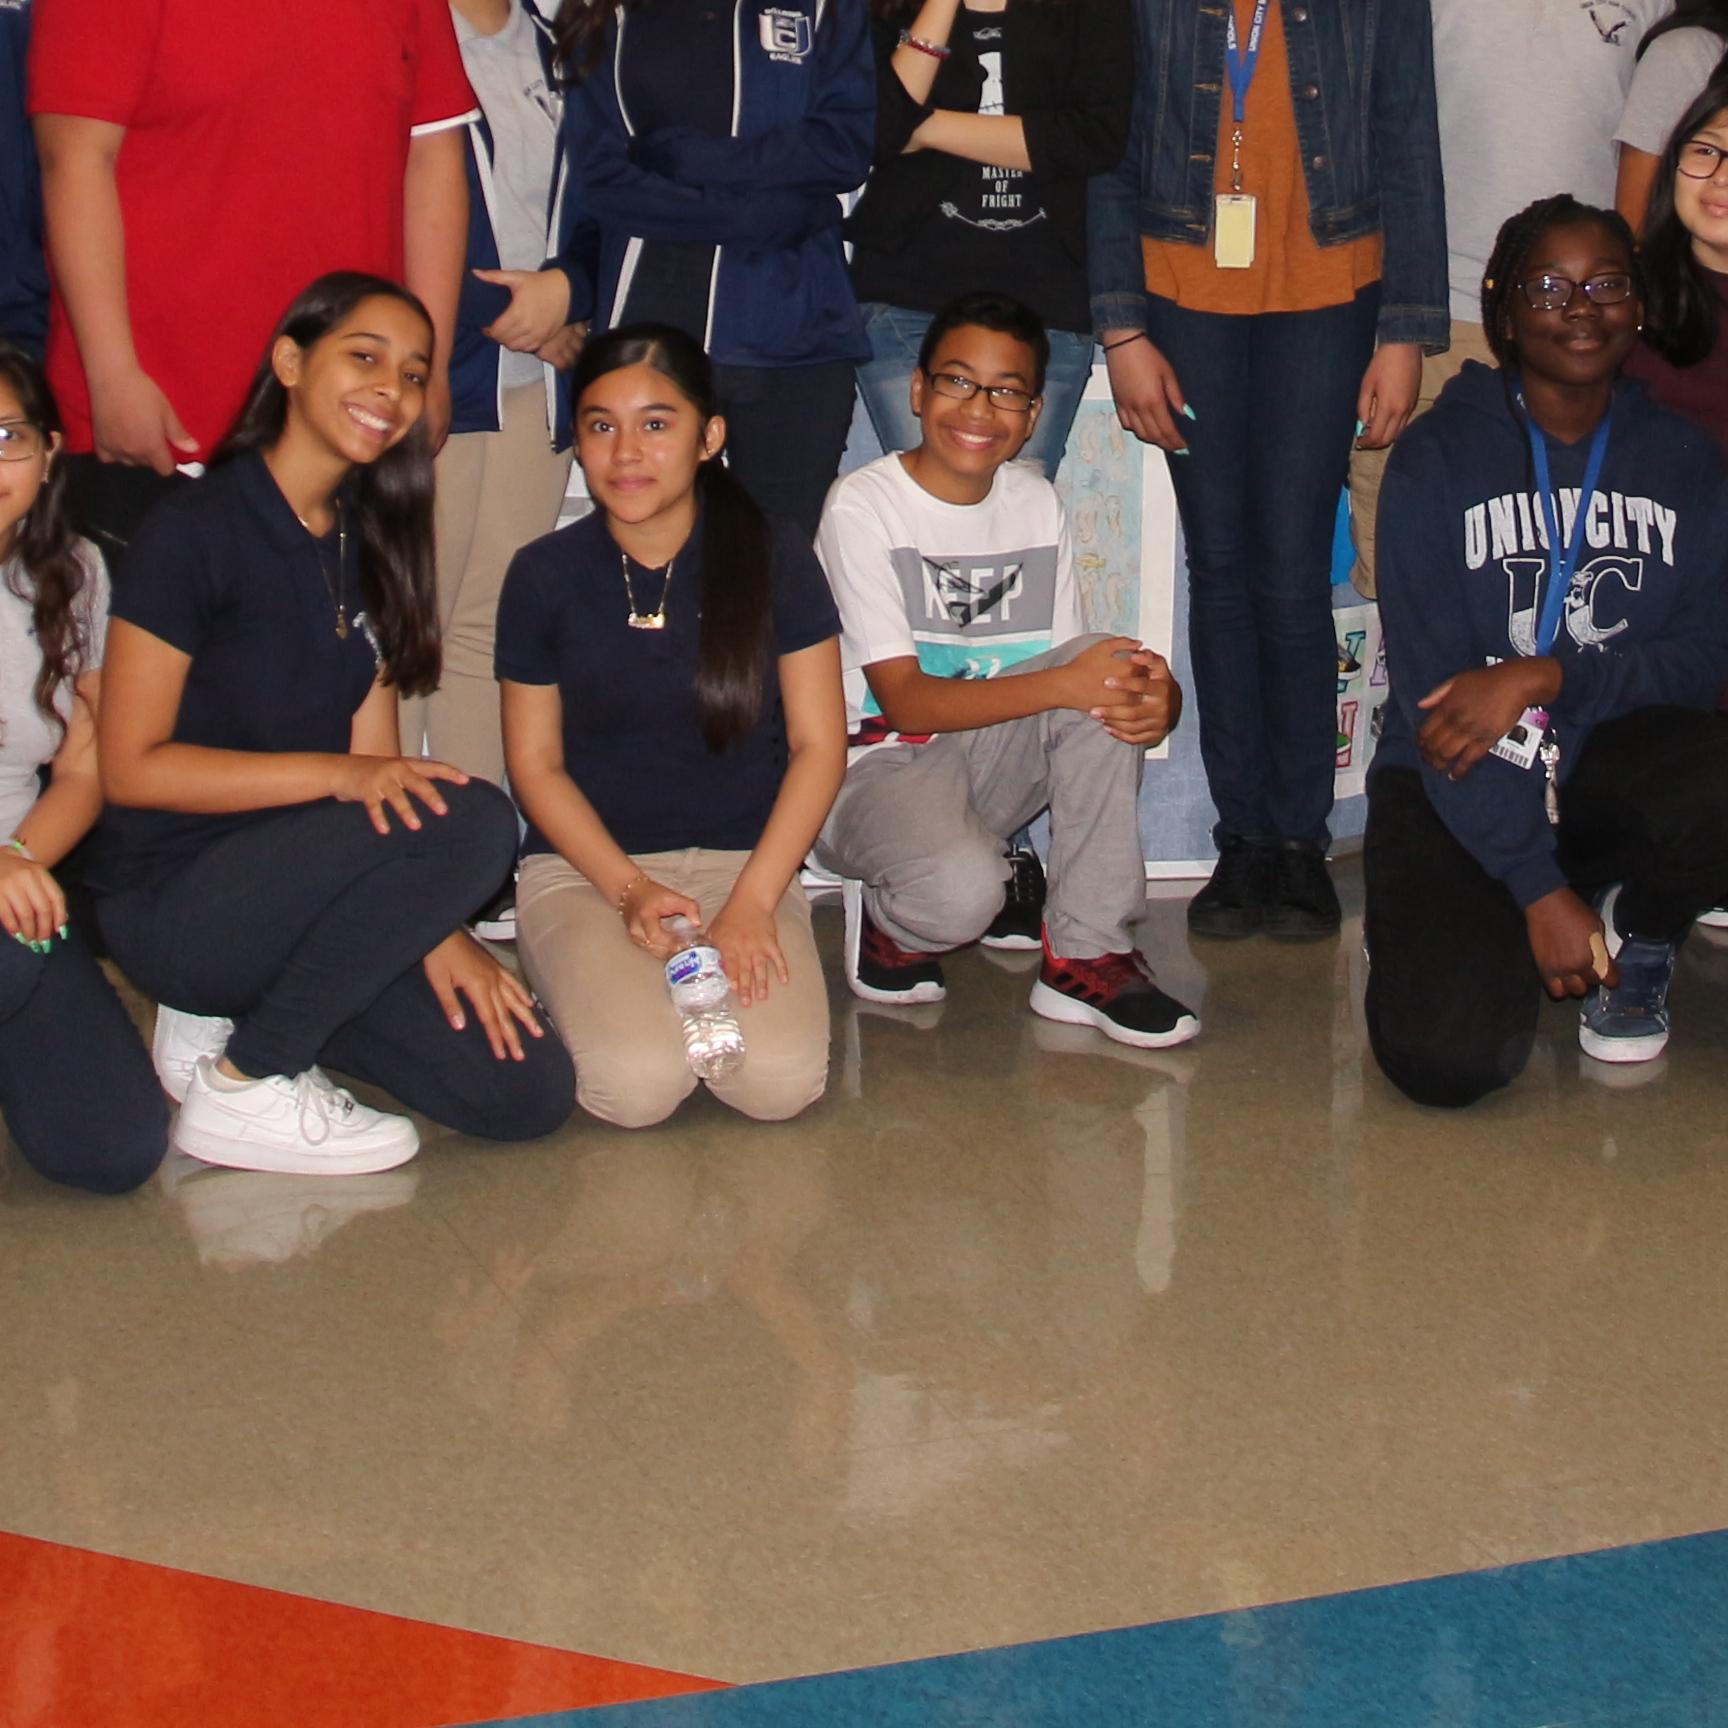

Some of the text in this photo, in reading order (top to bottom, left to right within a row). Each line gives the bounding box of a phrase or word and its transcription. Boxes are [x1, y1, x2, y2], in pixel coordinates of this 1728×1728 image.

[1253, 5, 1266, 26] CITY
[1248, 27, 1261, 53] UNION
[995, 180, 1009, 193] OF
[981, 194, 1023, 208] FRIGHT
[1585, 489, 1677, 568] CITY
[921, 560, 1024, 625] KEEP
[1502, 555, 1644, 659] UC
